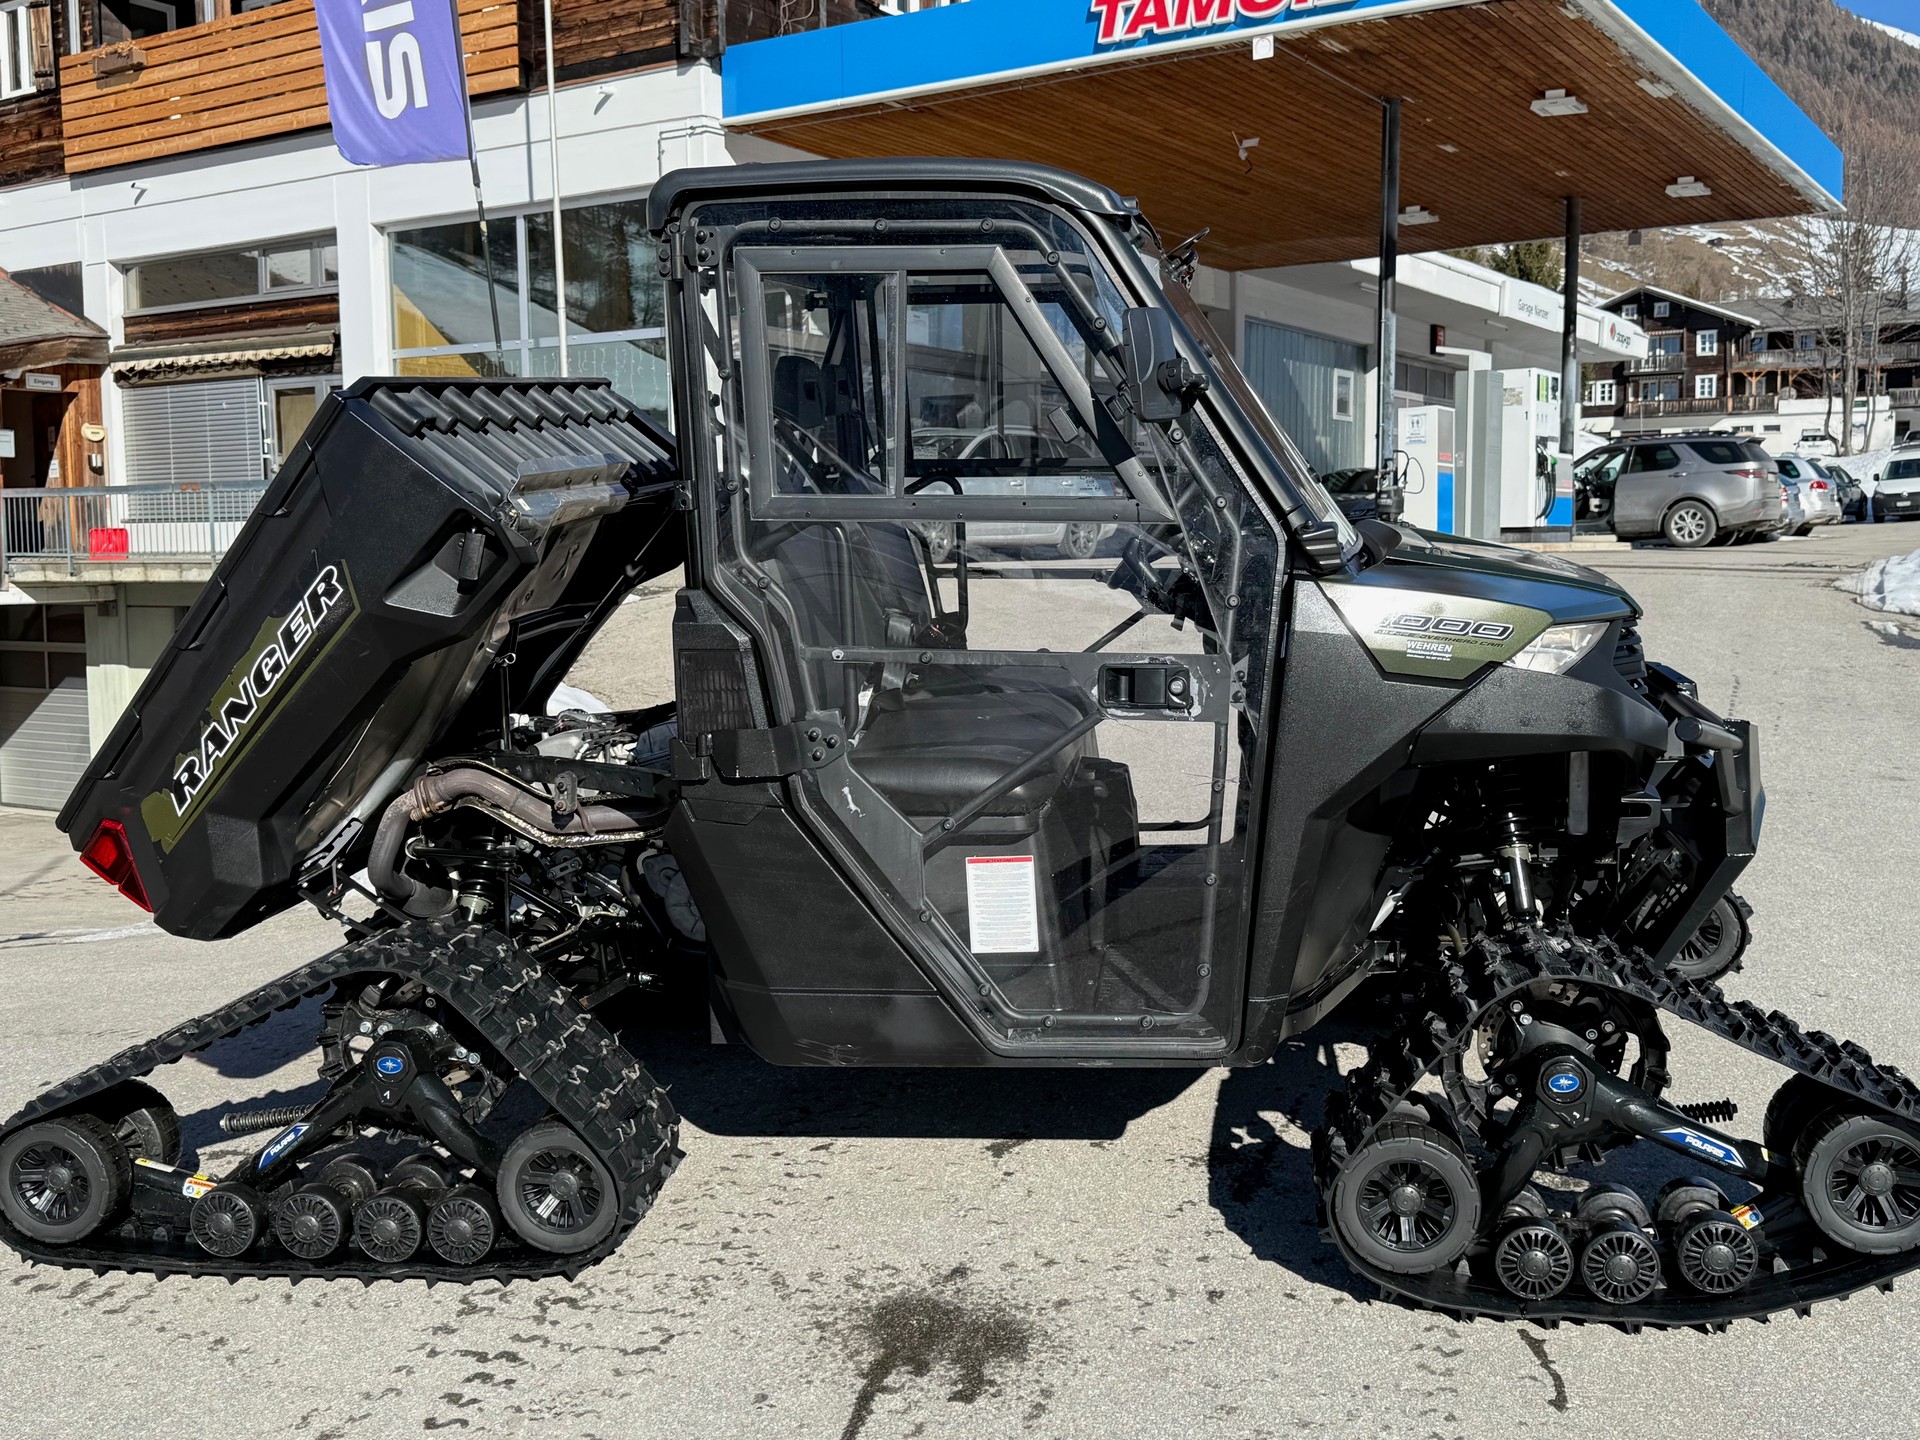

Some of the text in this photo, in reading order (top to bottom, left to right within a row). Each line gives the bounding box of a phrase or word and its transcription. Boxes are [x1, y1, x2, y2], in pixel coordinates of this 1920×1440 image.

[1518, 299, 1533, 317] Garage
[34, 378, 54, 386] Eingang
[1406, 640, 1453, 653] WEHREN
[1419, 634, 1478, 645] OVERHEAD
[1479, 640, 1505, 648] CAM
[170, 565, 343, 817] RANGER
[270, 1132, 295, 1156] POLARIS
[1685, 1135, 1726, 1158] POLARIS
